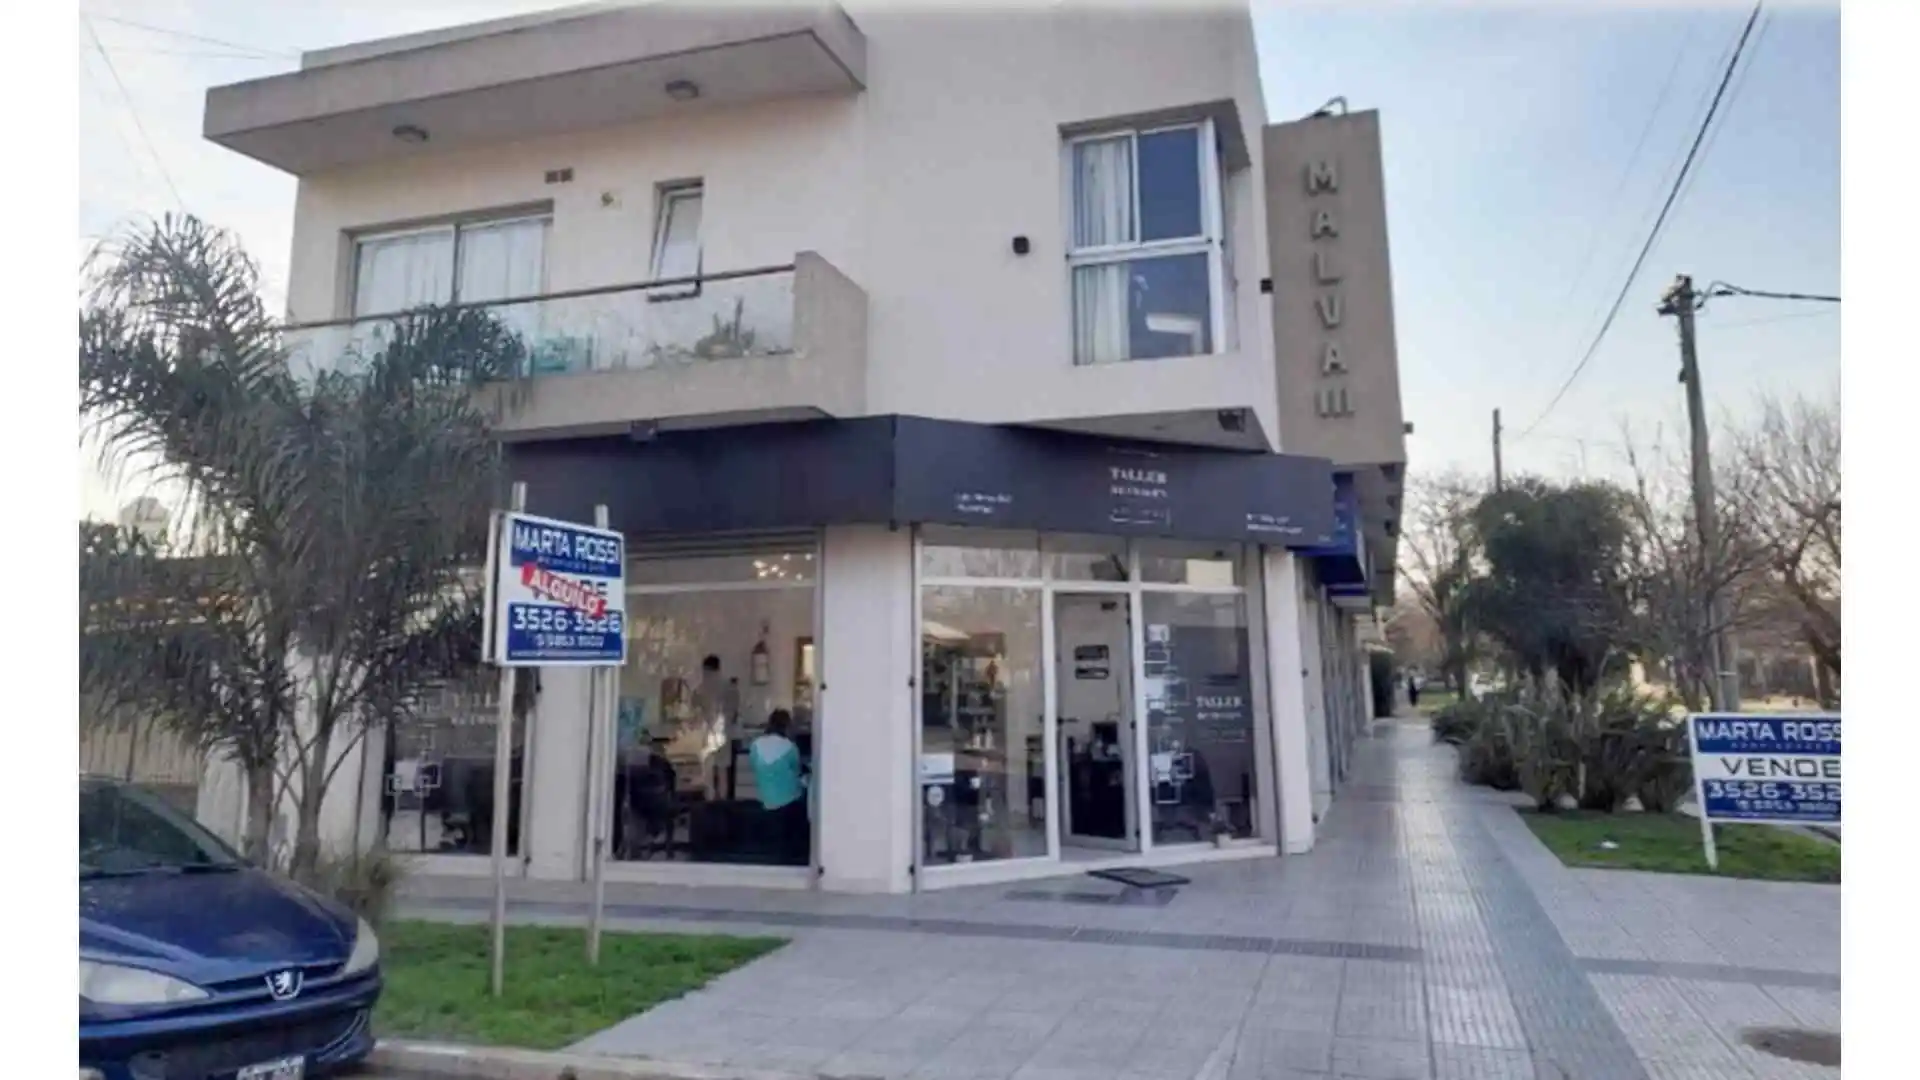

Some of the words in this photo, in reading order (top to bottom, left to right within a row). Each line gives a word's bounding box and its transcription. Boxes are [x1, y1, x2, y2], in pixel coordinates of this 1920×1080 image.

[515, 524, 572, 557] MARTA
[574, 534, 621, 563] ROSSI
[1697, 721, 1776, 740] MARTA
[1720, 757, 1841, 778] VENDE
